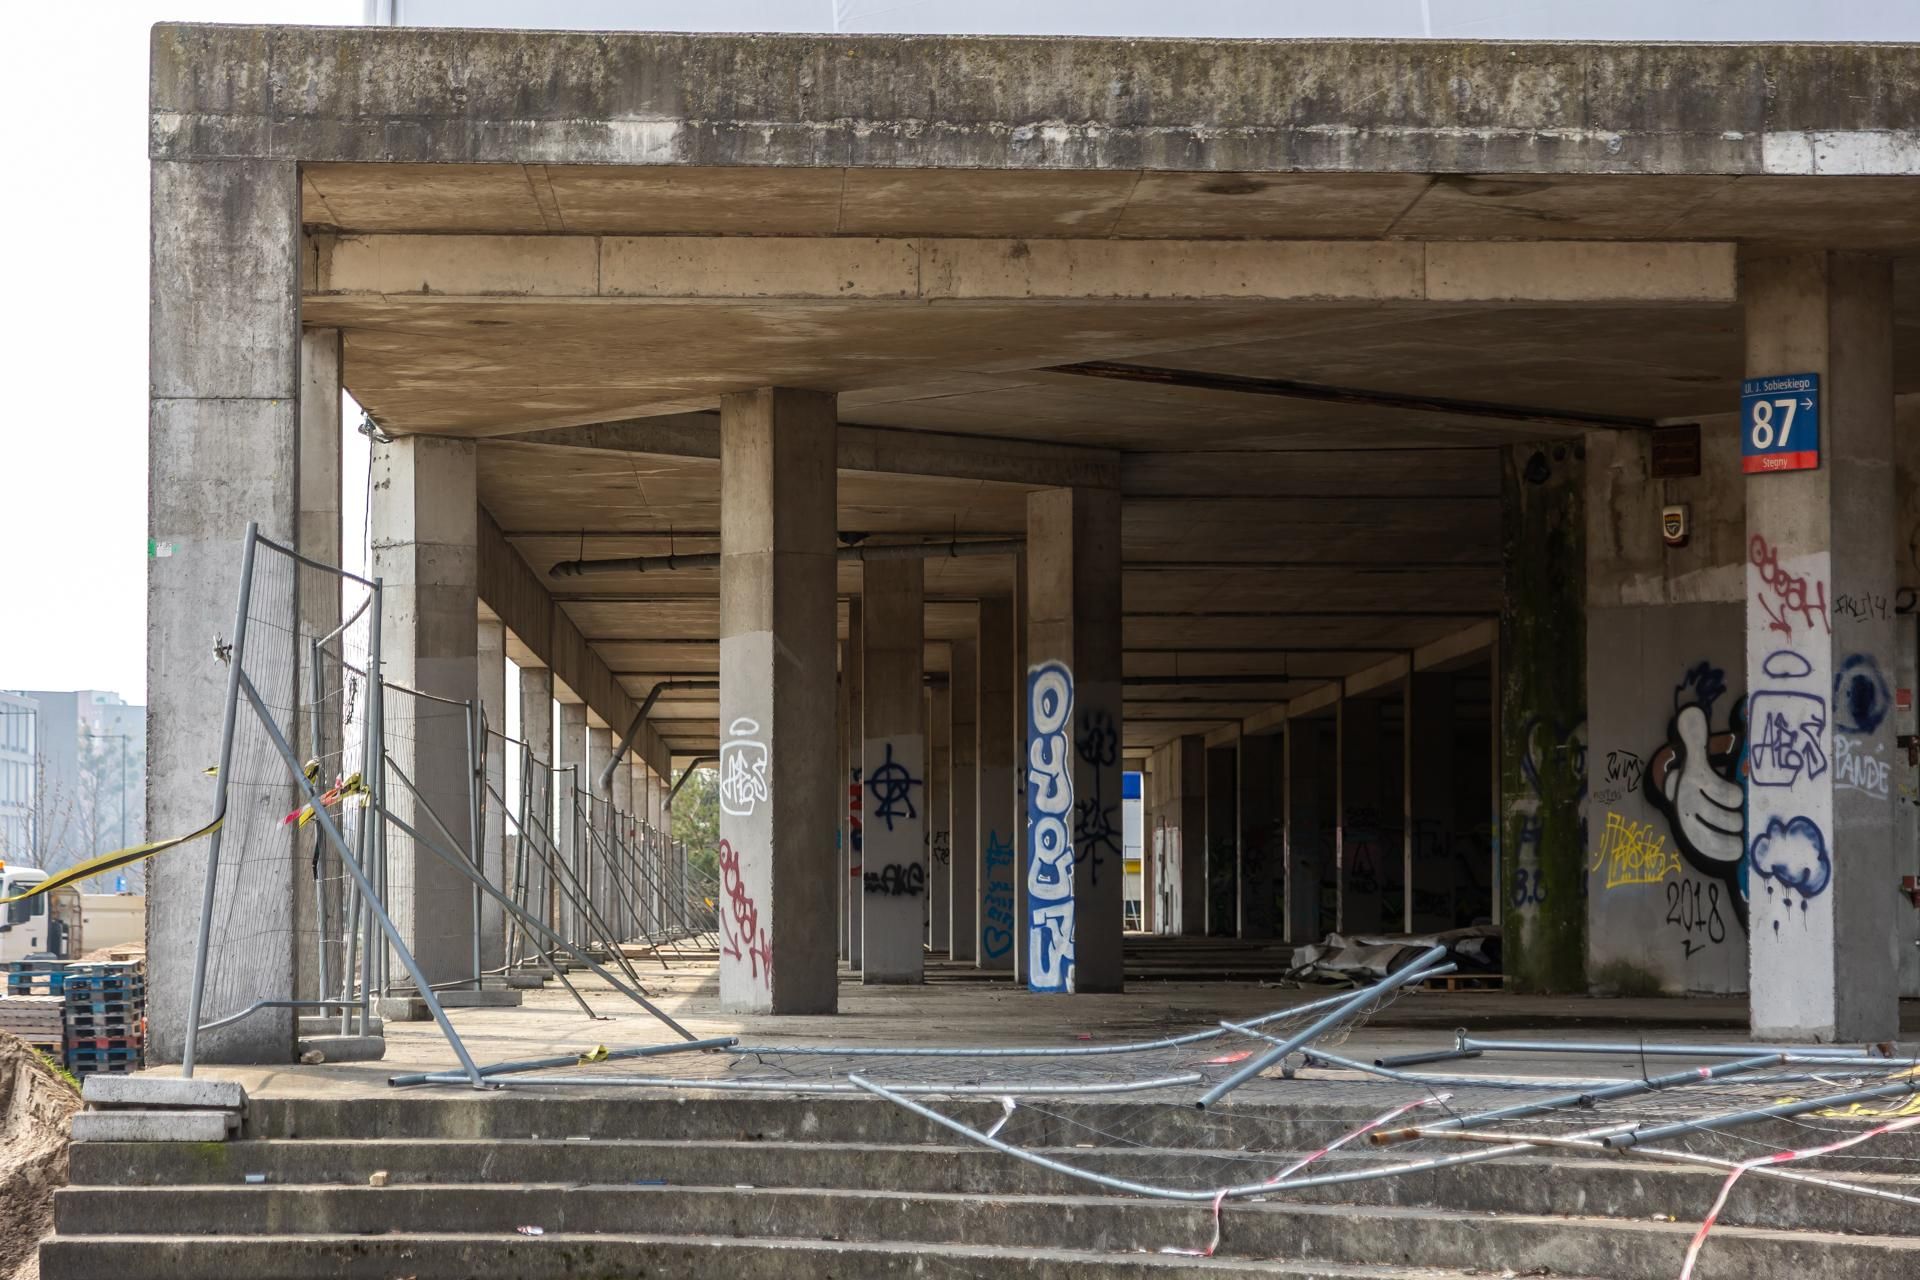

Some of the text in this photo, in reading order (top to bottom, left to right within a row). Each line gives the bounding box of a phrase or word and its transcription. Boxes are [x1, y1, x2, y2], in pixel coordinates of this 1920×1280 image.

[1764, 378, 1810, 392] Sobieskiego
[1752, 399, 1797, 449] 87
[1762, 457, 1788, 470] Stegny
[1666, 878, 1725, 944] 2018
